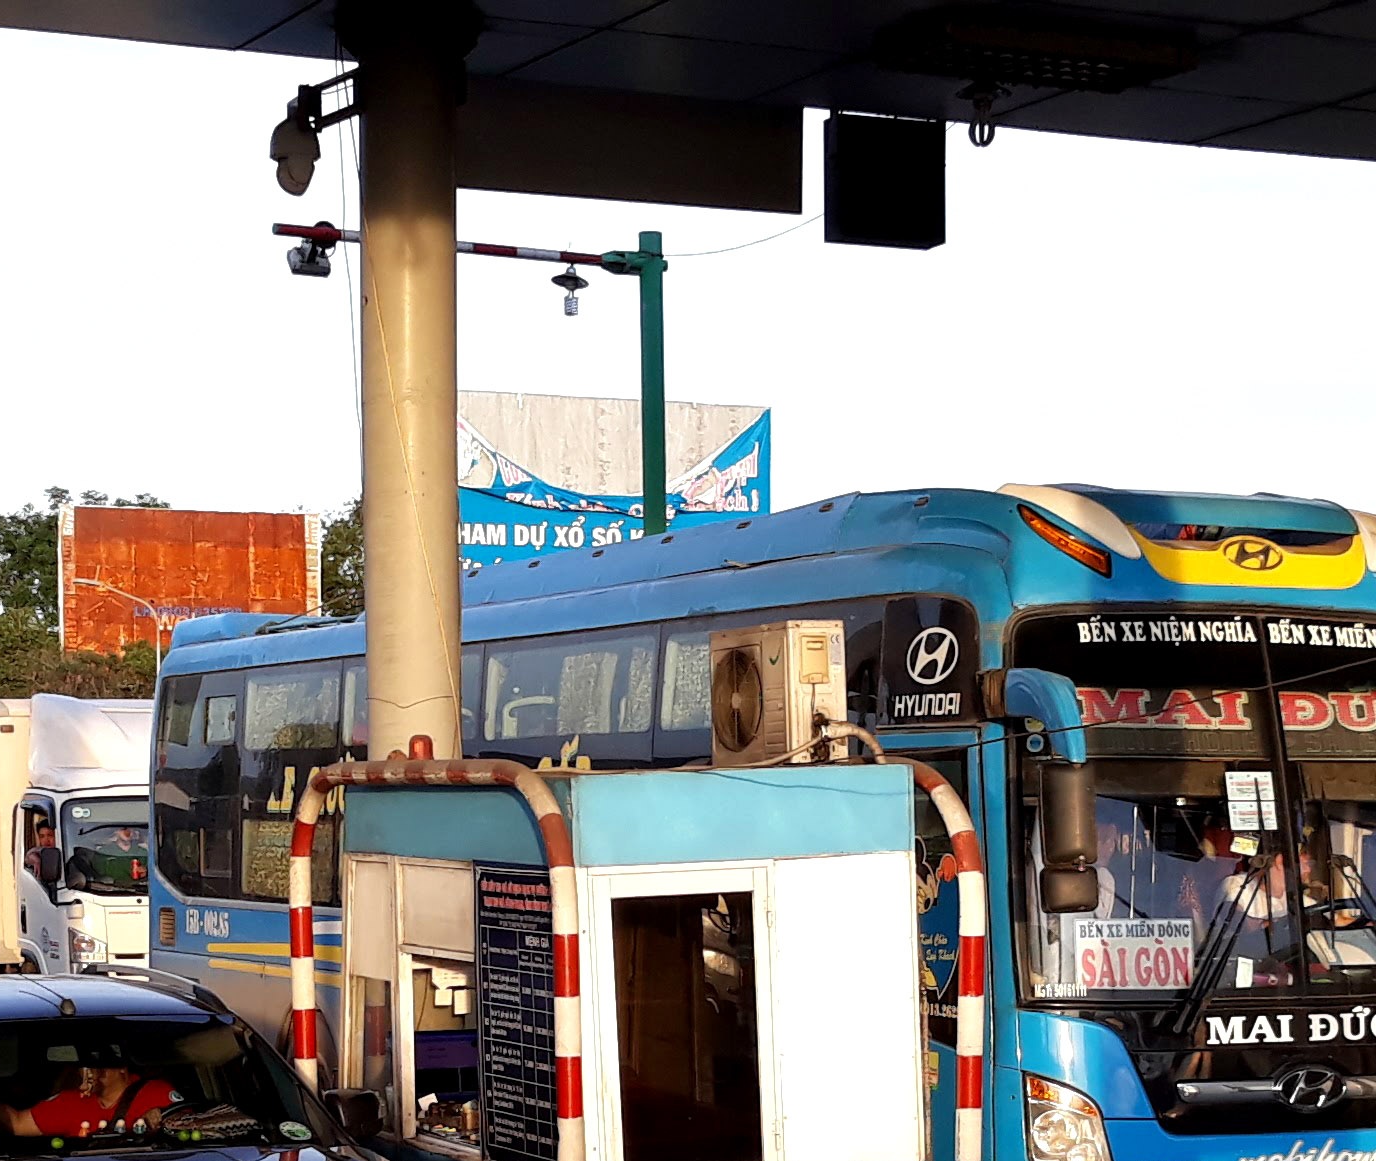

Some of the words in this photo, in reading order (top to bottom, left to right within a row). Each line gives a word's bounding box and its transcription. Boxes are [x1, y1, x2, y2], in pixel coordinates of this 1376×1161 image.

[458, 521, 506, 546] HAM
[514, 520, 548, 551] DỰ
[553, 515, 586, 548] XỔ
[1077, 616, 1116, 643] BẾN
[1121, 621, 1147, 642] XE
[1149, 616, 1195, 647] NIỆM
[1308, 623, 1334, 647] XE
[893, 692, 962, 718] HYUNDAI
[1076, 686, 1253, 731] MAI
[1106, 924, 1123, 938] XE
[1081, 938, 1129, 988] SÀI
[1134, 938, 1190, 987] GÒN
[1206, 1014, 1294, 1045] MAI
